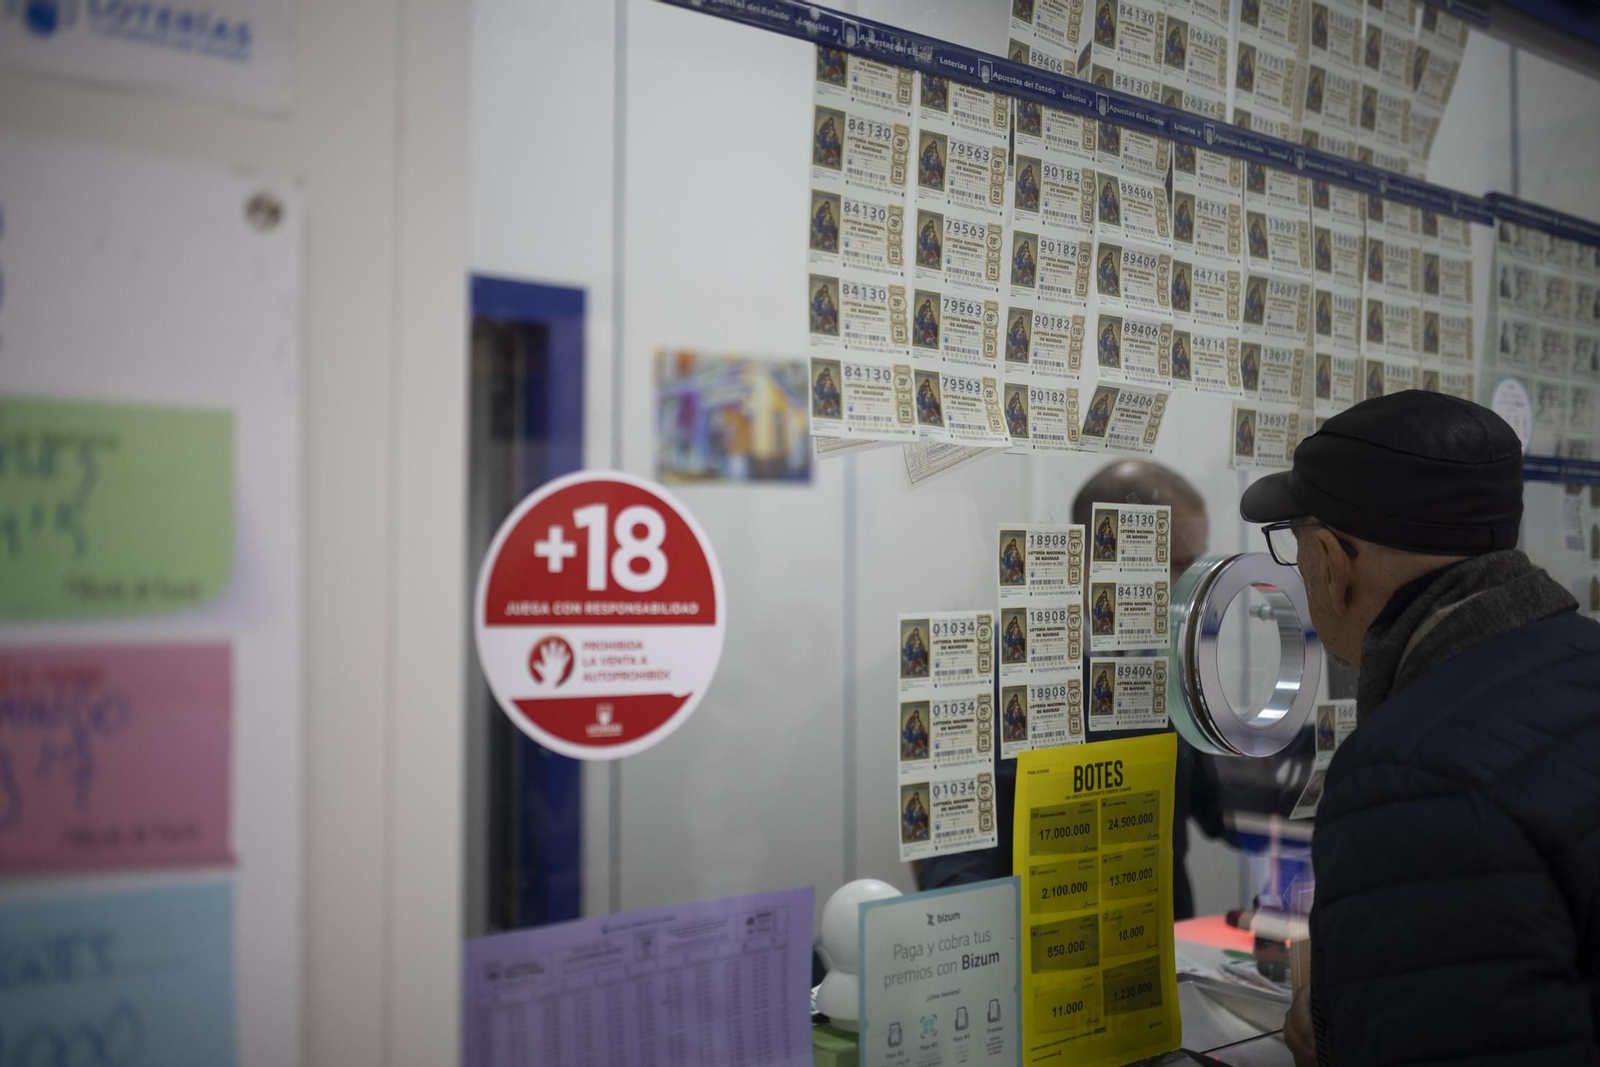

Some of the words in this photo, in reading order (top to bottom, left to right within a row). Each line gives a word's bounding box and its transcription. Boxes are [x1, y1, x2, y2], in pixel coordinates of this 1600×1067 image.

[761, 7, 790, 21] Estado
[1120, 5, 1154, 25] 84130
[832, 28, 838, 36] y
[895, 44, 906, 53] del
[1031, 52, 1062, 72] 89406
[970, 66, 974, 74] y
[993, 72, 1022, 86] Apuestas
[1024, 80, 1034, 89] del
[1035, 83, 1056, 95] Estado
[1115, 75, 1150, 94] 84130
[1184, 96, 1215, 115] 06324
[1109, 104, 1135, 118] Apuestas
[1136, 112, 1145, 120] del
[1146, 115, 1164, 126] Estado
[848, 118, 891, 140] 84130
[950, 141, 990, 162] 79563
[895, 170, 902, 179] 20
[1044, 165, 1080, 183] 90182
[993, 190, 1000, 198] 20
[1121, 182, 1152, 199] 89406
[844, 201, 886, 221] 84130
[1085, 210, 1091, 218] 20
[1197, 200, 1228, 217] 44714
[947, 220, 985, 238] 79563
[1041, 240, 1077, 256] 90182
[1123, 251, 1157, 268] 89406
[1195, 269, 1226, 284] 44714
[842, 283, 887, 300] 84130
[858, 308, 880, 316] NAVIDAD
[944, 299, 982, 316] 79563
[1035, 315, 1070, 330] 90182
[1124, 322, 1158, 337] 89406
[987, 344, 993, 352] 20
[1193, 337, 1225, 351] 44714
[844, 366, 892, 380] 84130
[943, 377, 981, 392] 79563
[1030, 390, 1064, 403] 90182
[1118, 393, 1153, 407] 89406
[901, 410, 909, 418] 20
[1121, 514, 1154, 525] 84130
[534, 503, 668, 593] +18
[1030, 535, 1066, 545] 18908
[1118, 587, 1153, 597] 84130
[505, 600, 550, 616] JUEGA
[552, 601, 582, 616] CON
[584, 602, 700, 616] RESPONSABILIDAD
[1030, 611, 1066, 622] 18908
[933, 622, 975, 634] 01034
[583, 642, 643, 651] PROHIBIDA
[583, 658, 596, 667] LA
[600, 656, 636, 666] VENTA
[640, 656, 648, 664] A
[1118, 666, 1151, 677] 89406
[1031, 686, 1066, 699] 18908
[933, 701, 975, 716] 01034
[981, 738, 988, 746] 20
[1074, 760, 1123, 793] BOTES
[933, 781, 975, 797] 01034
[1108, 812, 1153, 830] 24.500.000
[1039, 823, 1090, 840] 17.000.000
[1110, 868, 1152, 886] 13.700.000
[1042, 881, 1088, 900] 2.100.000
[937, 912, 960, 923] bizum
[1118, 925, 1144, 941] 10.000
[894, 944, 923, 962] Paga
[927, 942, 935, 958] y
[938, 934, 970, 952] cobra
[974, 930, 992, 944] tus
[1047, 940, 1085, 958] 850.000
[884, 966, 933, 991] premios
[937, 962, 957, 976] con
[962, 952, 1000, 970] Bizum
[1114, 981, 1152, 1001] 1.230.000
[1052, 1001, 1083, 1018] 11.000
